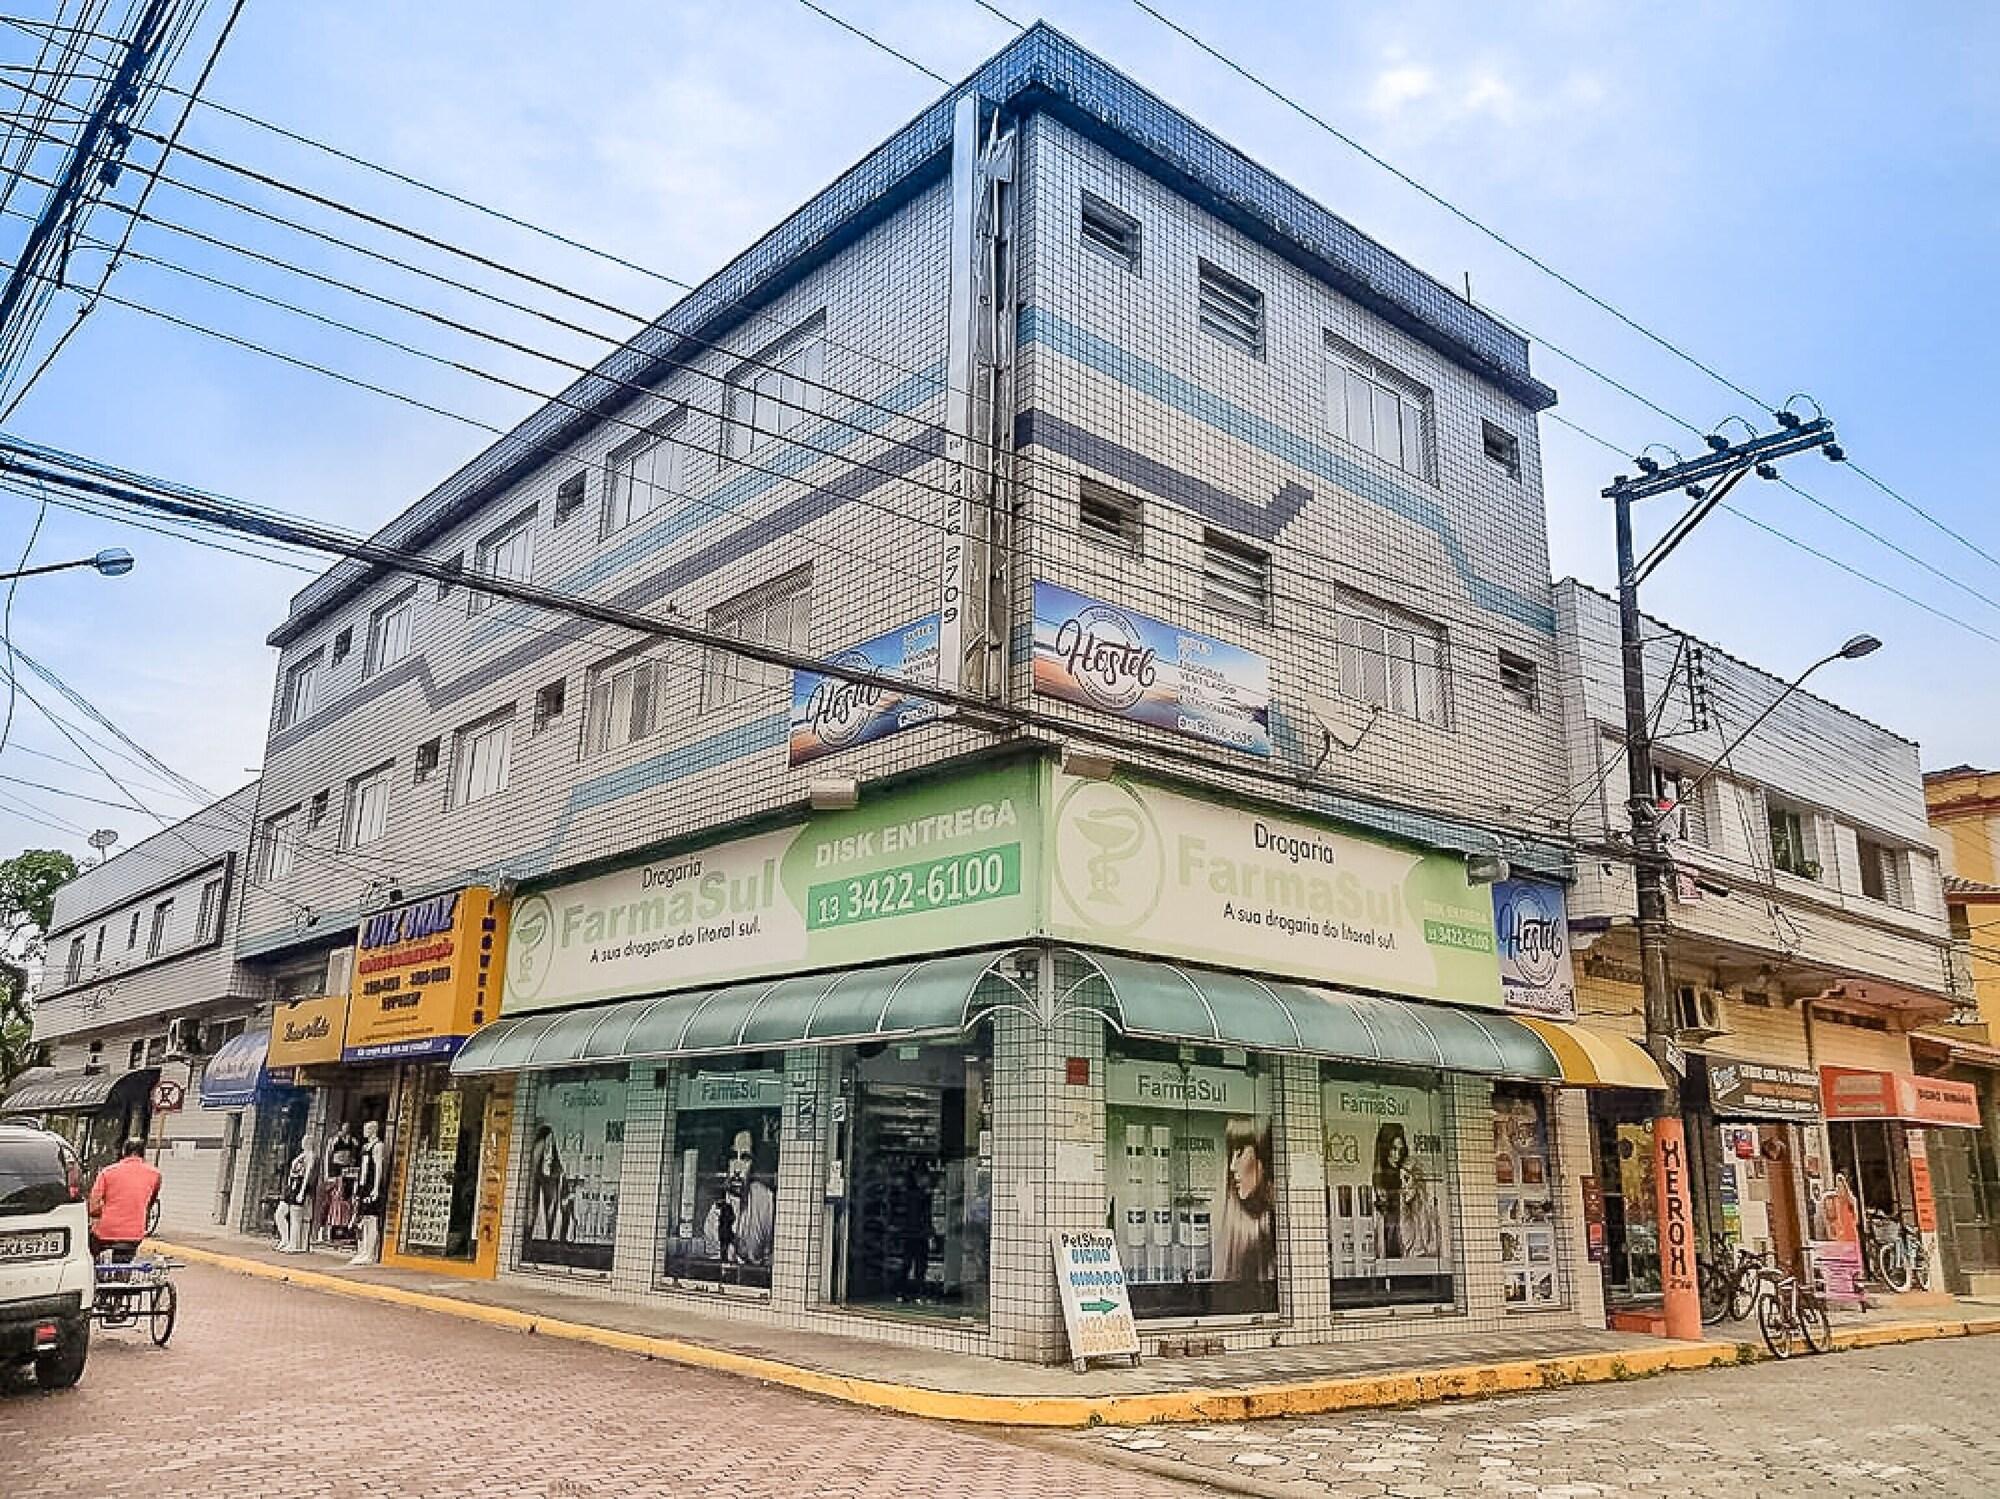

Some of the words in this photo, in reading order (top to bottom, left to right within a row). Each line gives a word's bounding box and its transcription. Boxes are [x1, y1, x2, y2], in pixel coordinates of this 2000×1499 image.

[1055, 618, 1156, 688] Hostel
[815, 831, 875, 869] DISK
[880, 798, 1018, 852] ENTREGA
[1253, 822, 1335, 864] Drogaria
[641, 854, 704, 889] Drogaria
[817, 894, 841, 923] 13
[847, 852, 1004, 919] 3422-6100
[1176, 833, 1403, 927] FarmaSul
[561, 857, 776, 948] FarmaSul
[1223, 900, 1235, 919] A
[1237, 908, 1262, 925] sua
[1264, 908, 1319, 936] drogaria
[1321, 919, 1339, 939] do
[1341, 920, 1375, 946] litoral
[590, 948, 599, 963] A
[601, 948, 621, 962] sua
[623, 934, 675, 957] drogaria
[677, 929, 695, 947] do
[697, 917, 736, 945] litoral
[1137, 1074, 1228, 1103] FarmaSul
[1341, 1092, 1409, 1117] FarmaSul
[1061, 1232, 1113, 1250] PetShop
